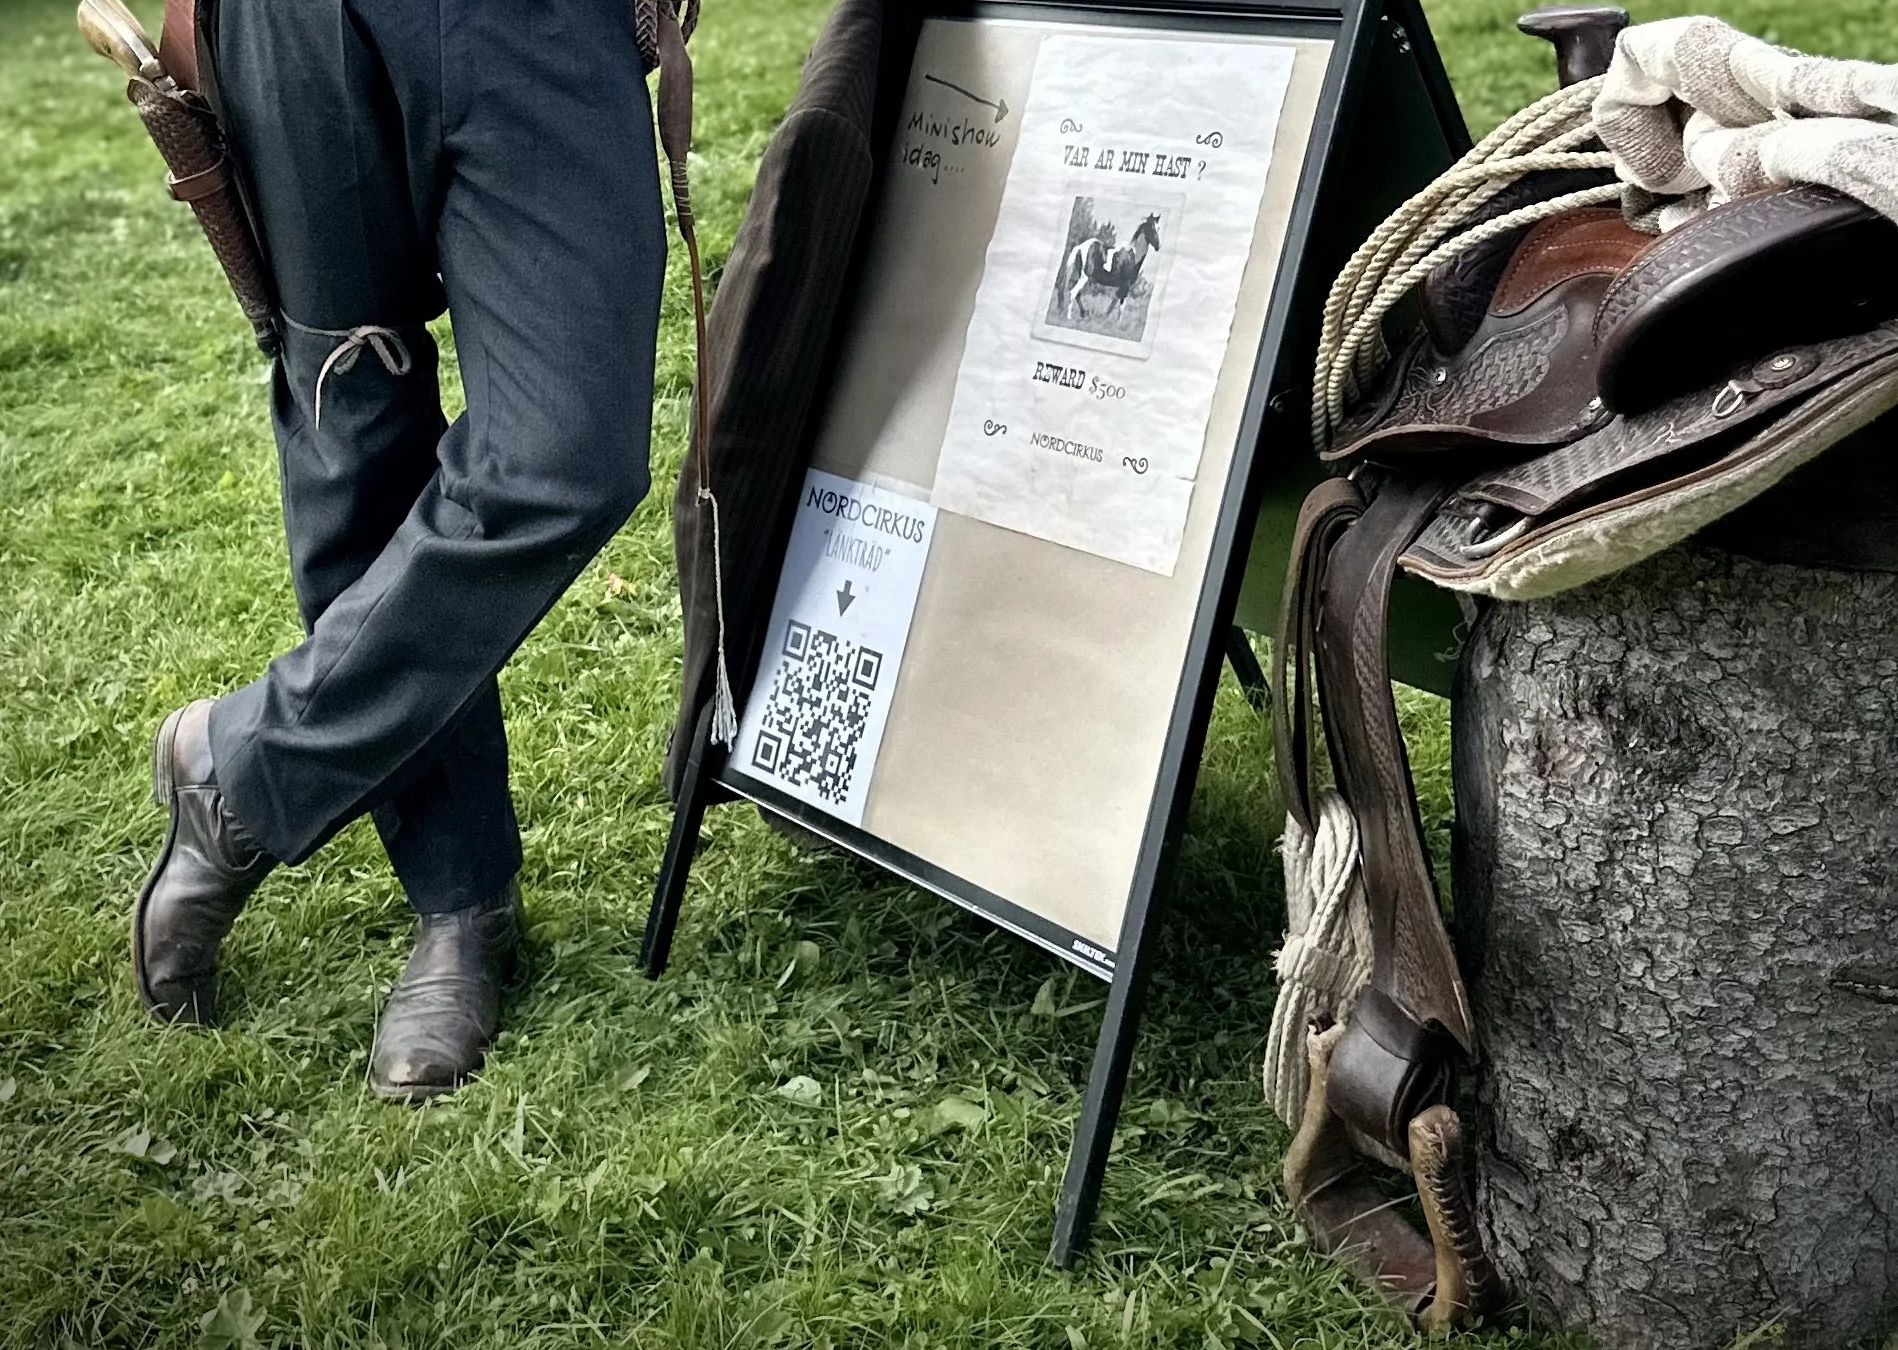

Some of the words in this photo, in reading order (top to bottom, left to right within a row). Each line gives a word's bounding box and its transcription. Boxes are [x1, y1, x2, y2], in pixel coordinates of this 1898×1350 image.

[1063, 144, 1090, 168] VAR
[1118, 150, 1150, 175] MIN
[1032, 360, 1087, 391] REWARD
[1088, 375, 1126, 400] $500
[1029, 431, 1104, 463] NORDCIRKUS
[806, 485, 925, 544] NORDCIRKUS
